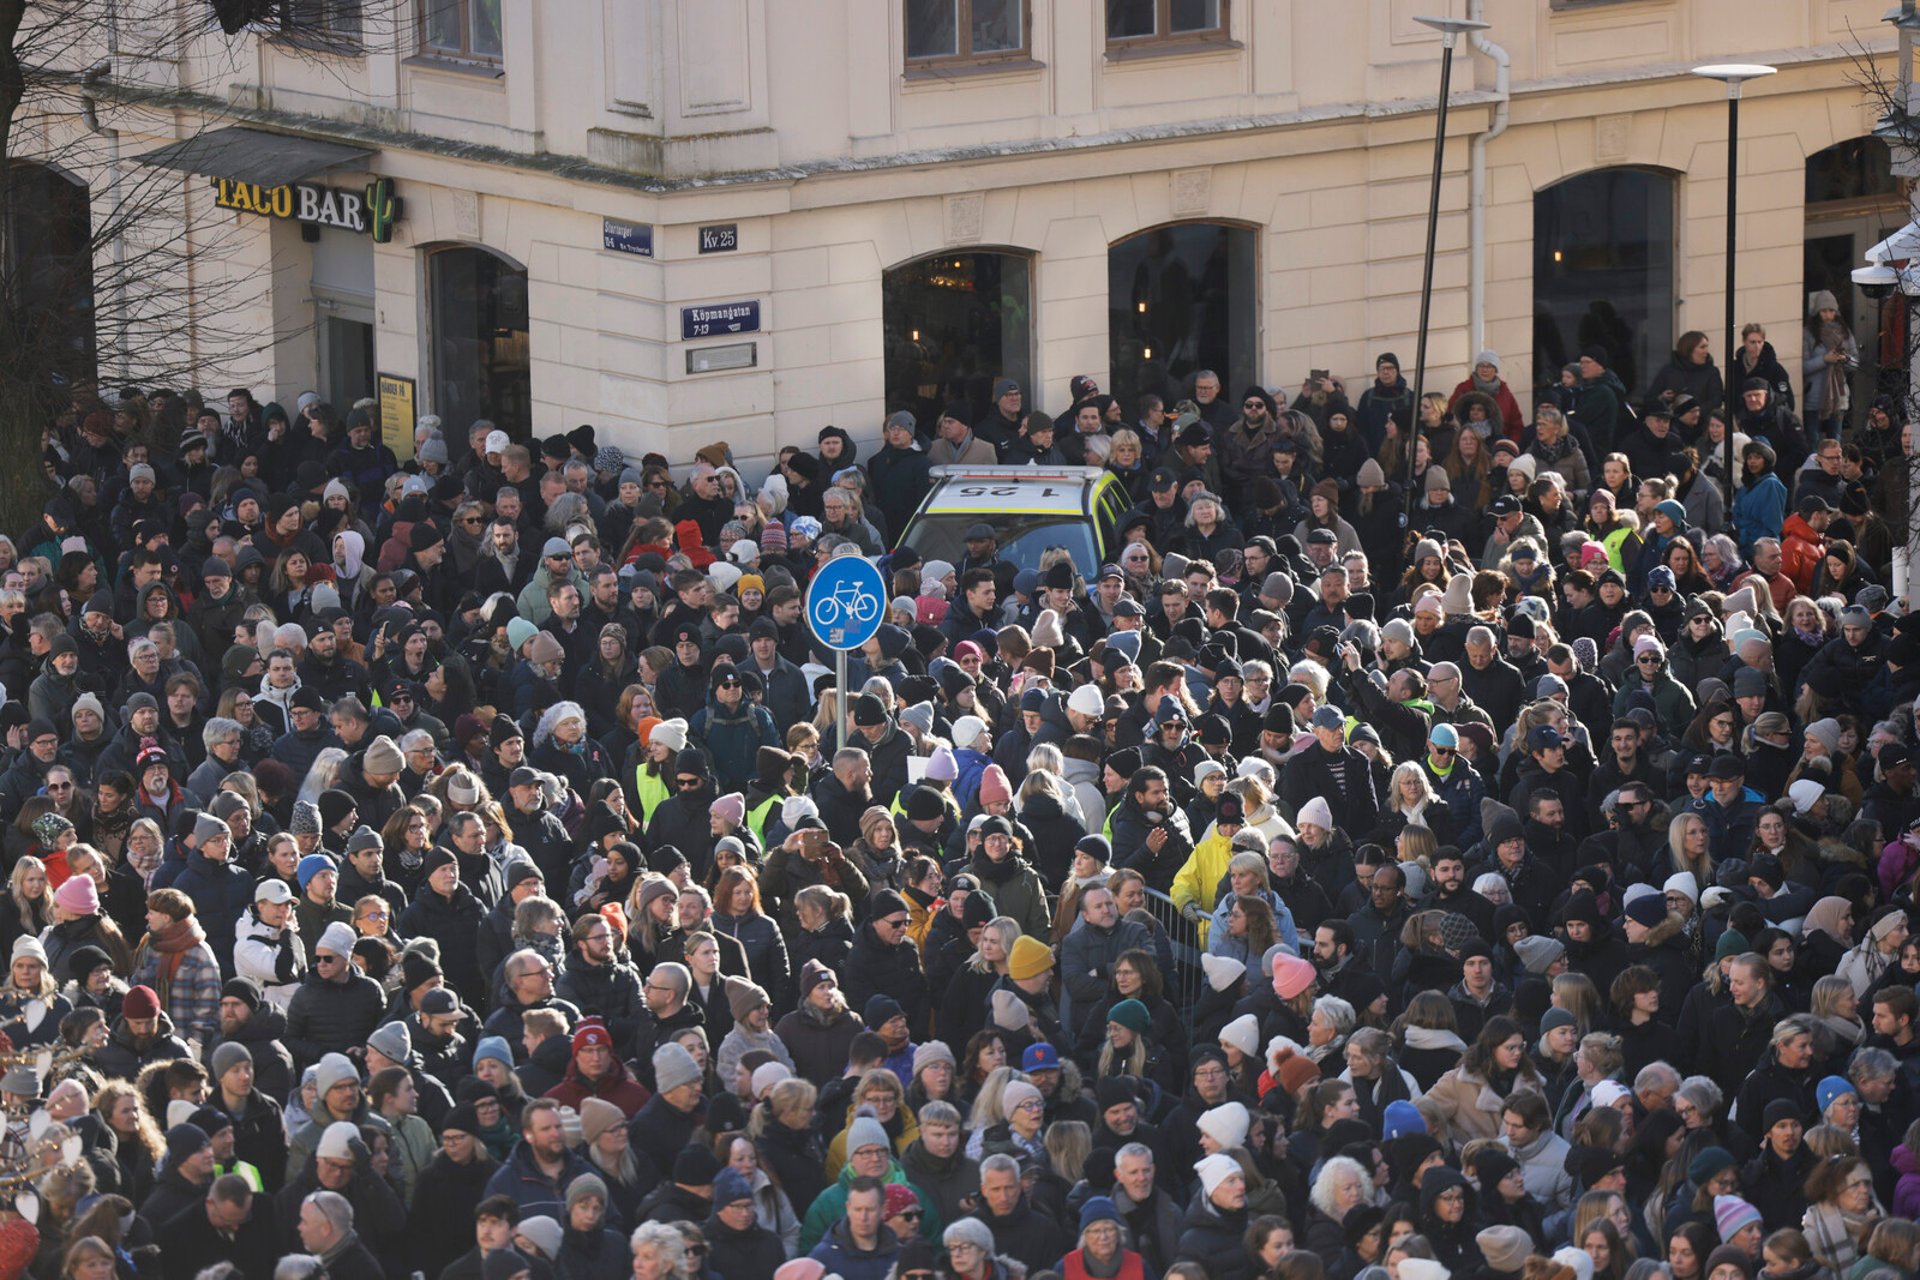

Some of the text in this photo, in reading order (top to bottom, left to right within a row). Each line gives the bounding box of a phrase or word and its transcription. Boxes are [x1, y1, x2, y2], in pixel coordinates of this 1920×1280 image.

[212, 176, 364, 231] TACO BAR
[703, 228, 735, 249] Kv. 25
[692, 306, 750, 322] Köpmangatan
[694, 324, 709, 336] 7-13
[960, 487, 1060, 497] 1 25
